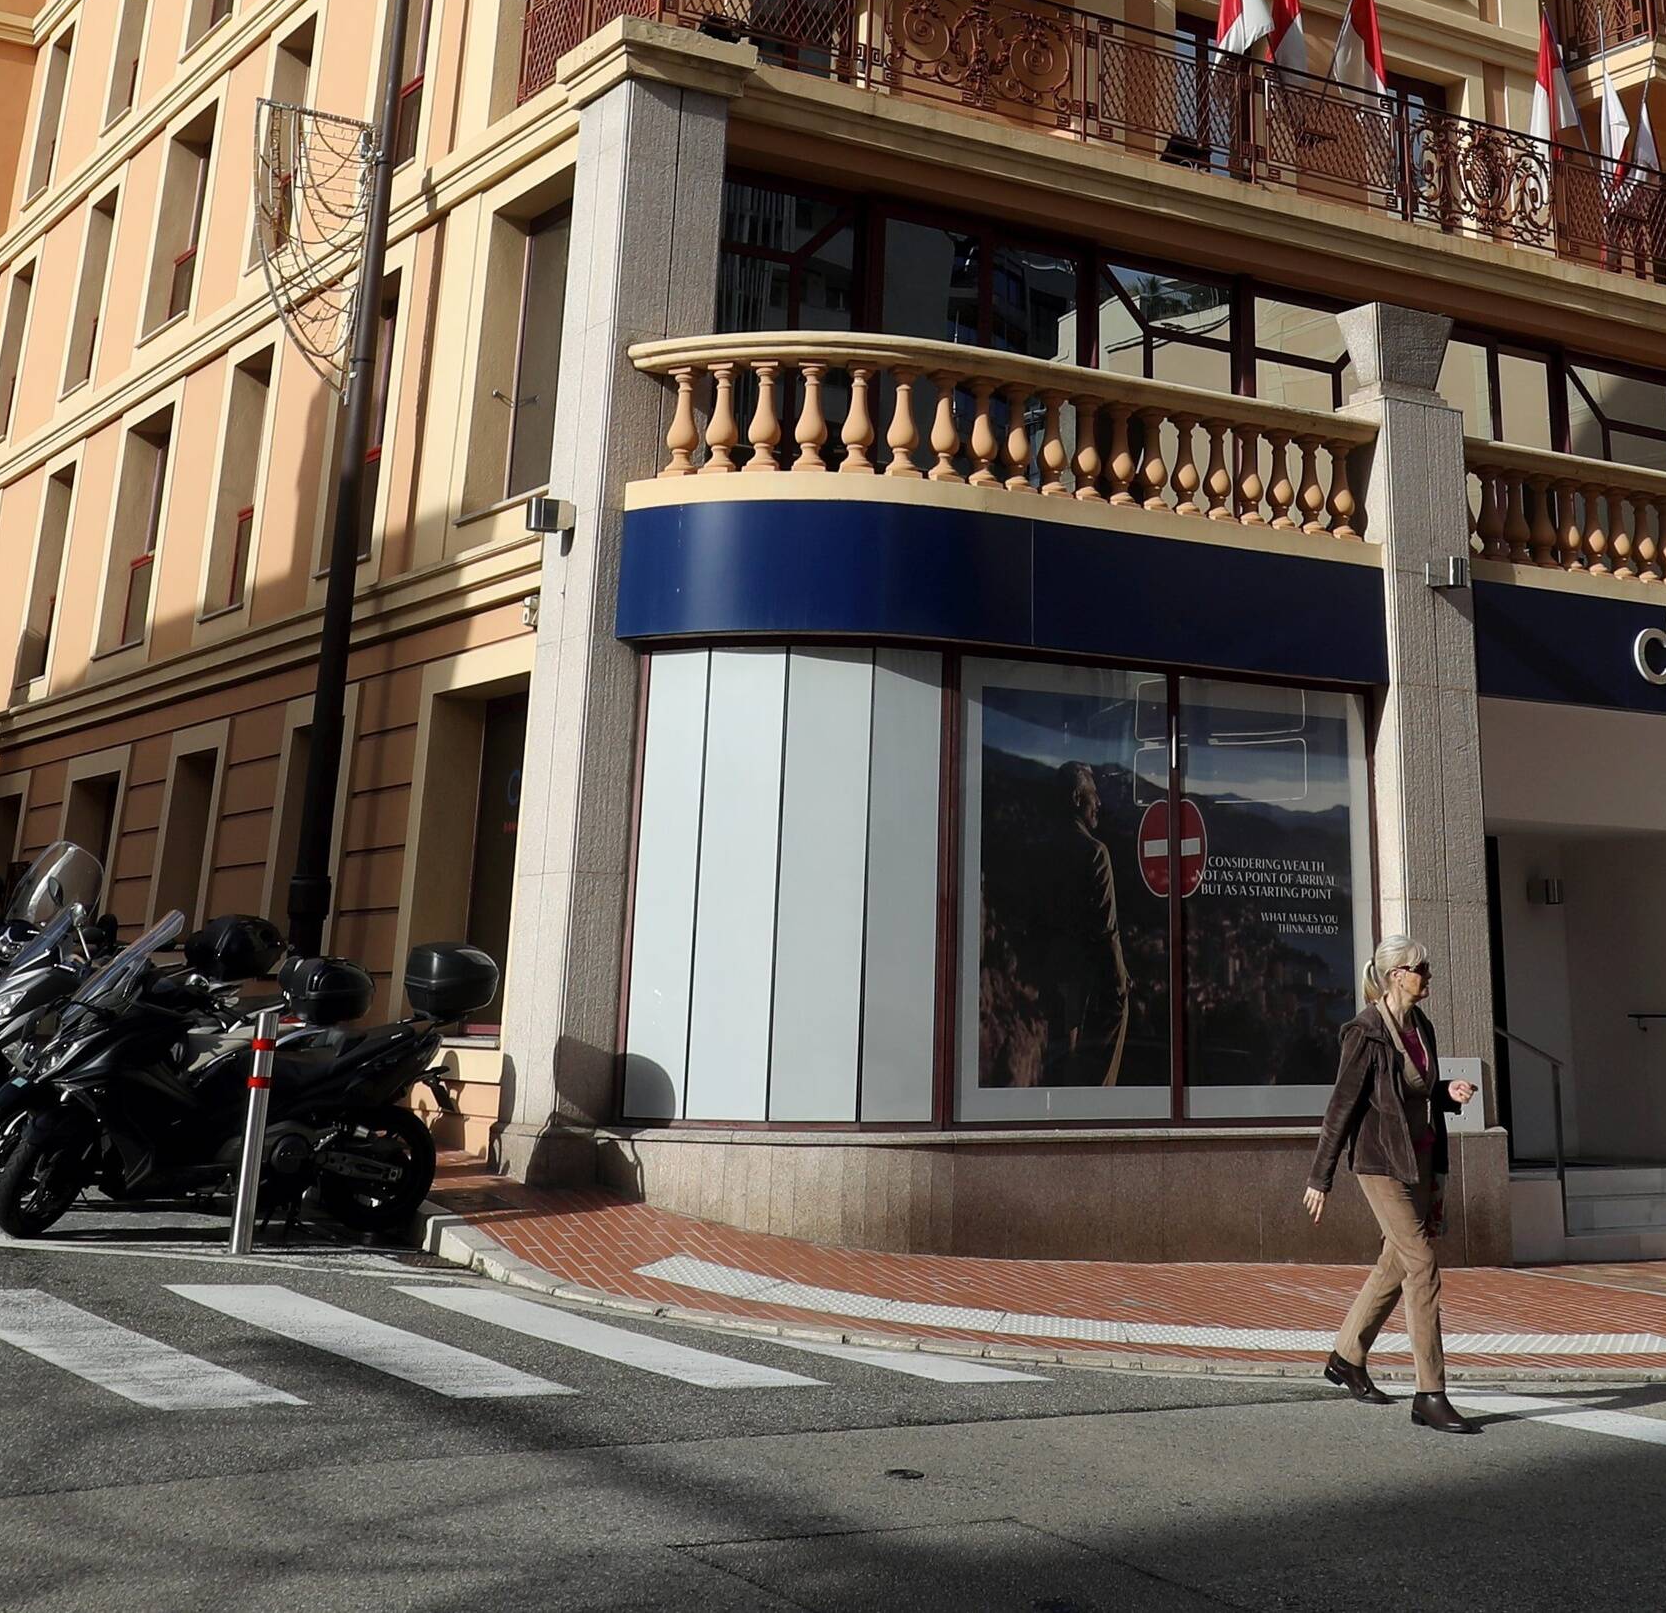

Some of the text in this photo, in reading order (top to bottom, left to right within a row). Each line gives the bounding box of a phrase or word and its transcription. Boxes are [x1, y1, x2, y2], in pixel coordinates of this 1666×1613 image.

[1208, 856, 1325, 872] CONSIDERING WEALTH
[1196, 869, 1218, 881] NOT
[1220, 870, 1234, 882] AS
[1235, 871, 1243, 882] A
[1245, 872, 1277, 884] POINT
[1279, 873, 1294, 884] OF
[1201, 884, 1333, 900] BUT AS A STARTING POINT
[1260, 912, 1339, 924] WHAT MAKES YOU
[1277, 923, 1339, 935] THINK AHEAD?
